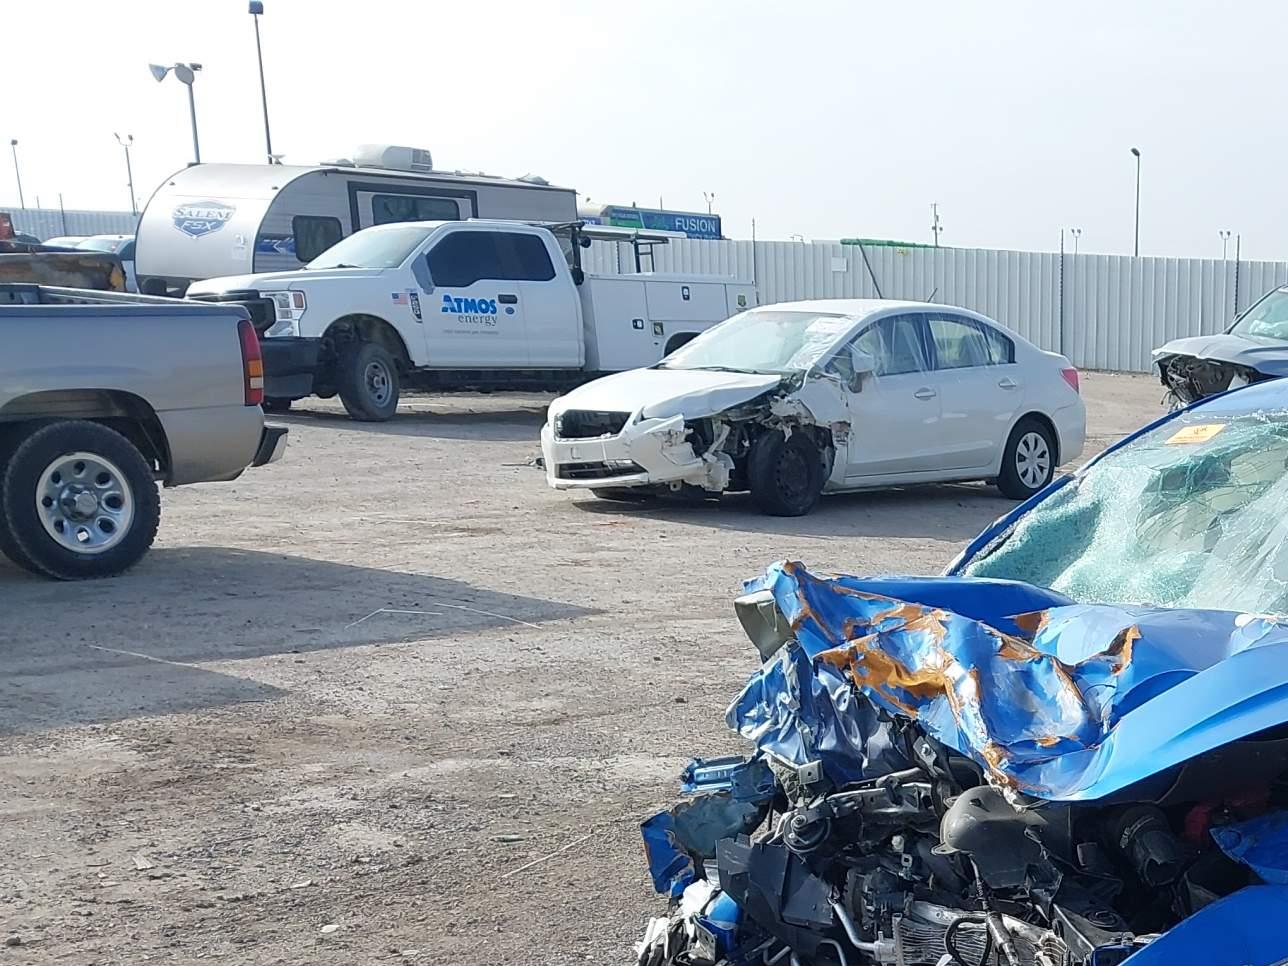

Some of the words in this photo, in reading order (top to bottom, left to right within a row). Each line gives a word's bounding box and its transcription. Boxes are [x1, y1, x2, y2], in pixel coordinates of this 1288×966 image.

[675, 217, 716, 233] FUSION
[441, 294, 498, 314] ATMOS
[457, 314, 498, 327] energy
